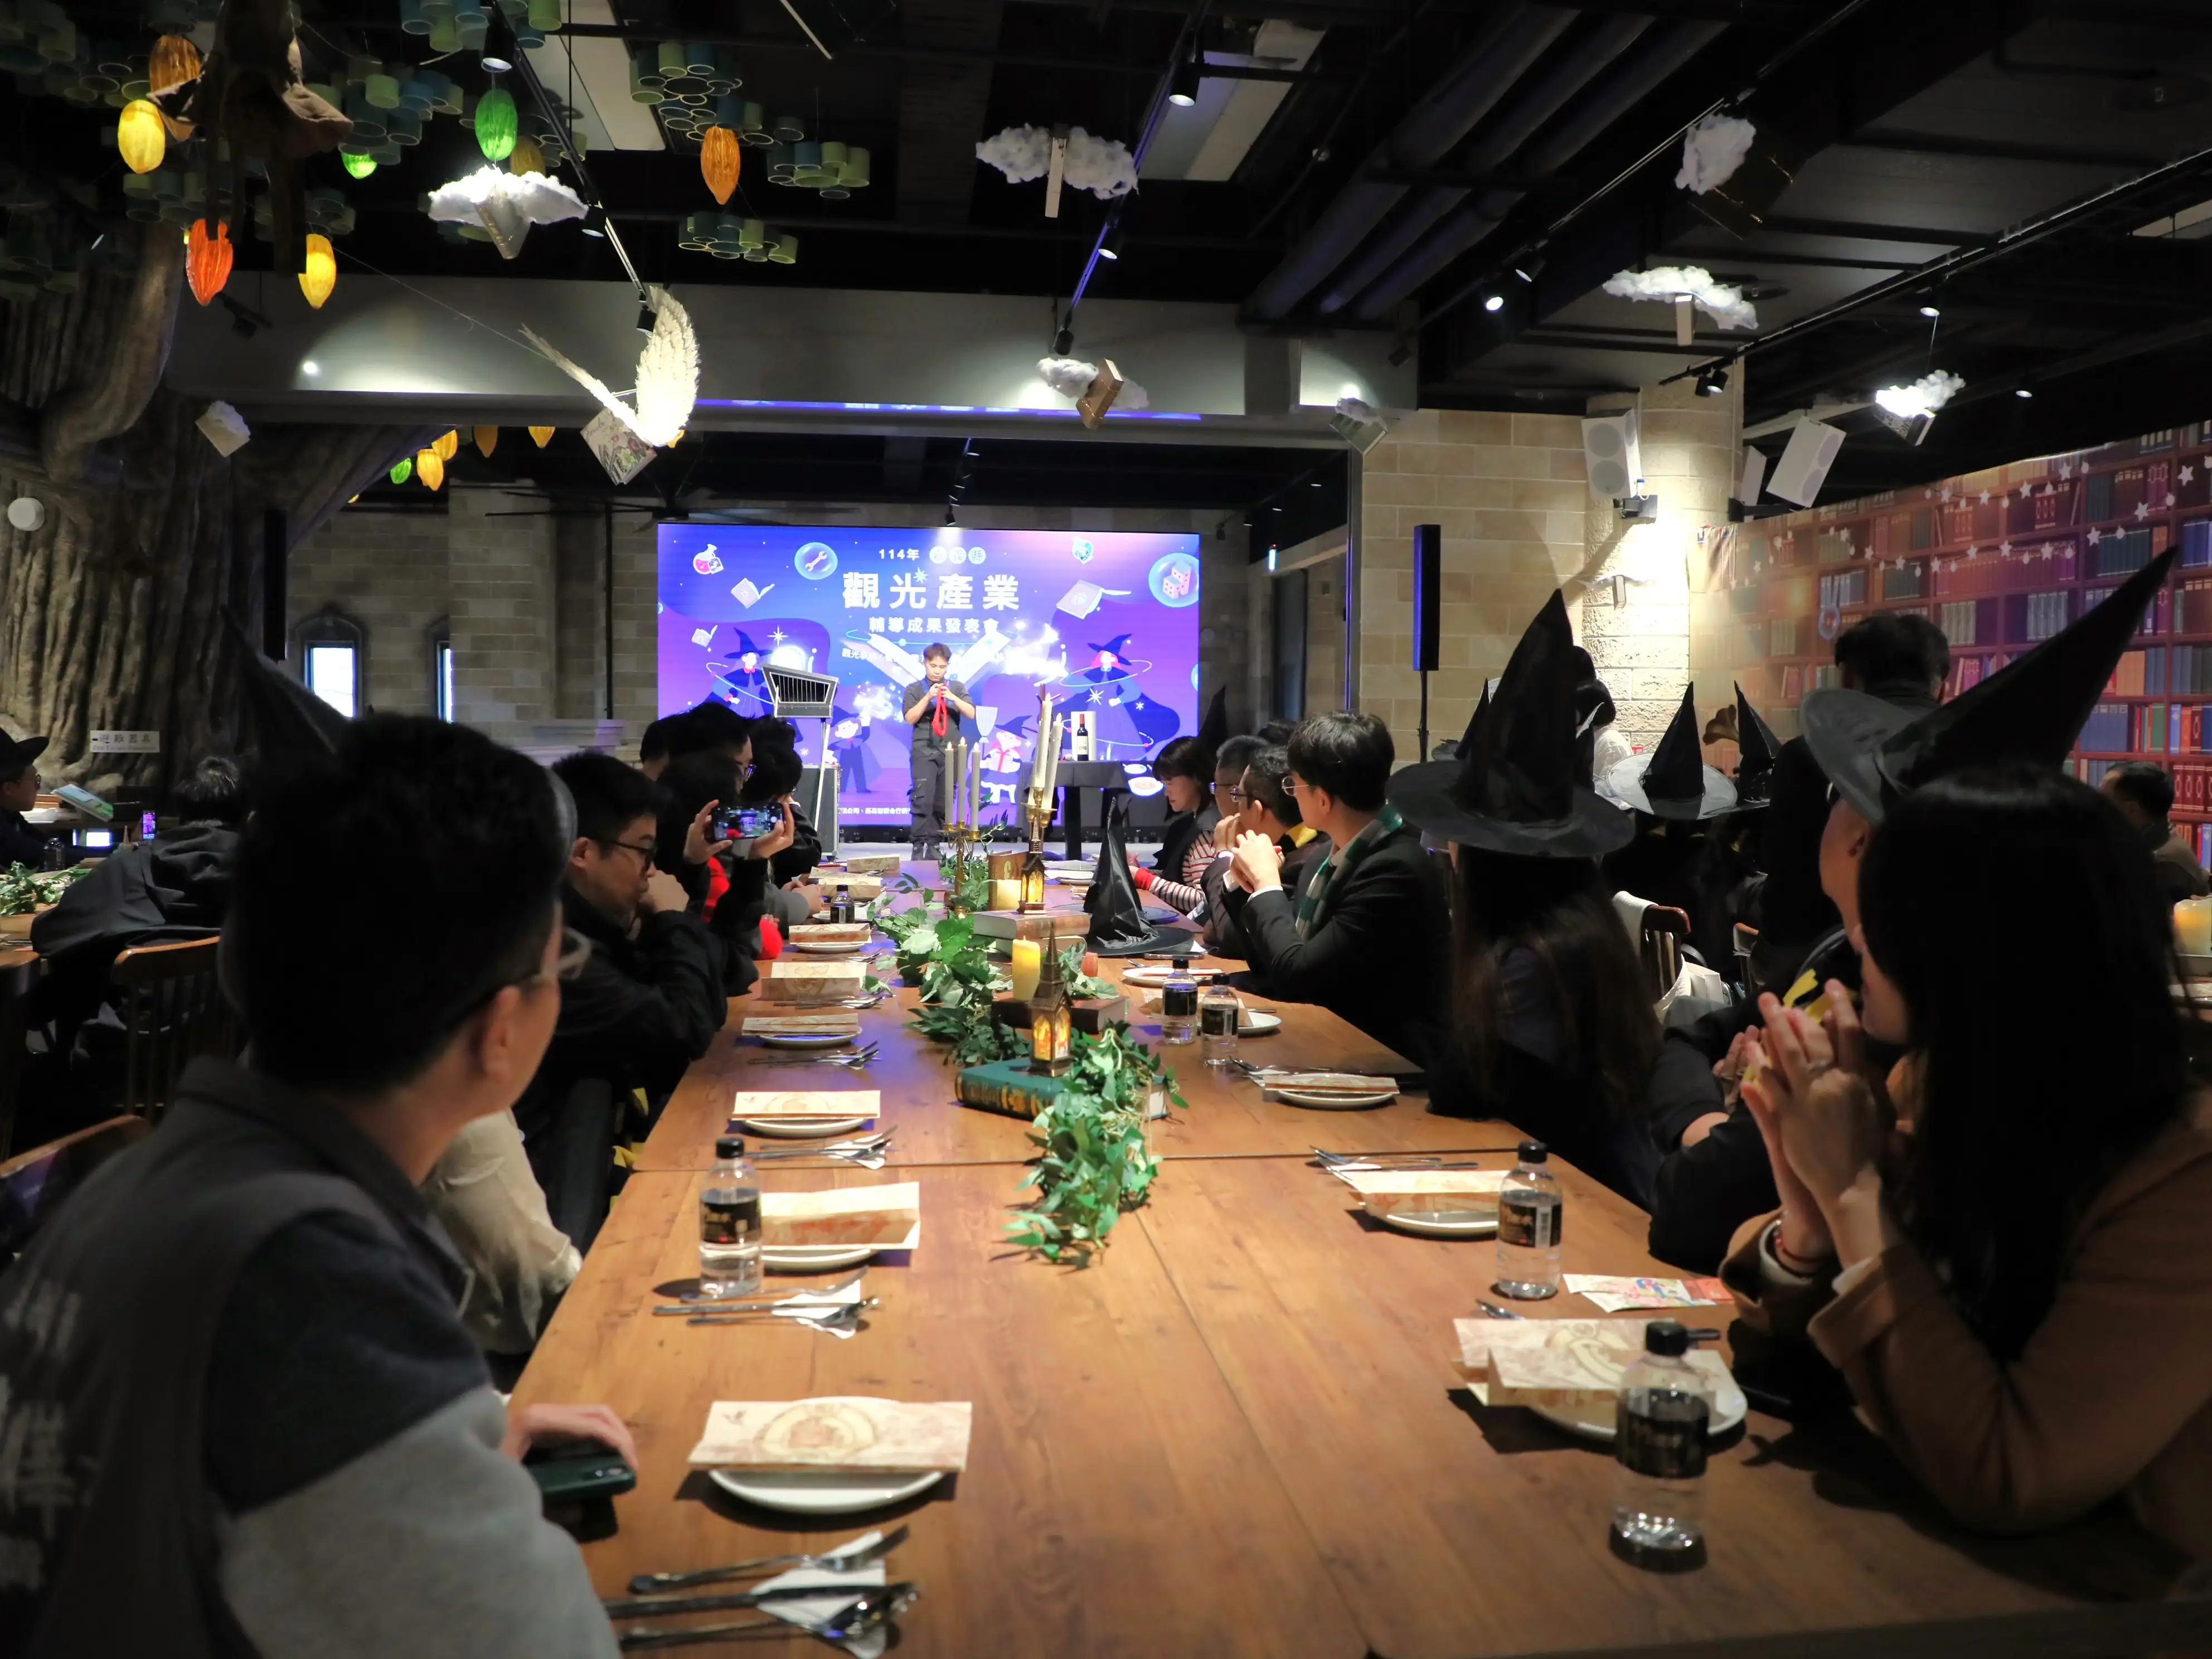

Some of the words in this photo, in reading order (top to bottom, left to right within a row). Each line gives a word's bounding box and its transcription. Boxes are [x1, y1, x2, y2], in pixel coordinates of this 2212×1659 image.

[879, 548, 920, 561] 114年
[842, 571, 1020, 611] 觀光產業
[868, 616, 1000, 634] 輔導成果發表會
[99, 734, 152, 744] 避難器具
